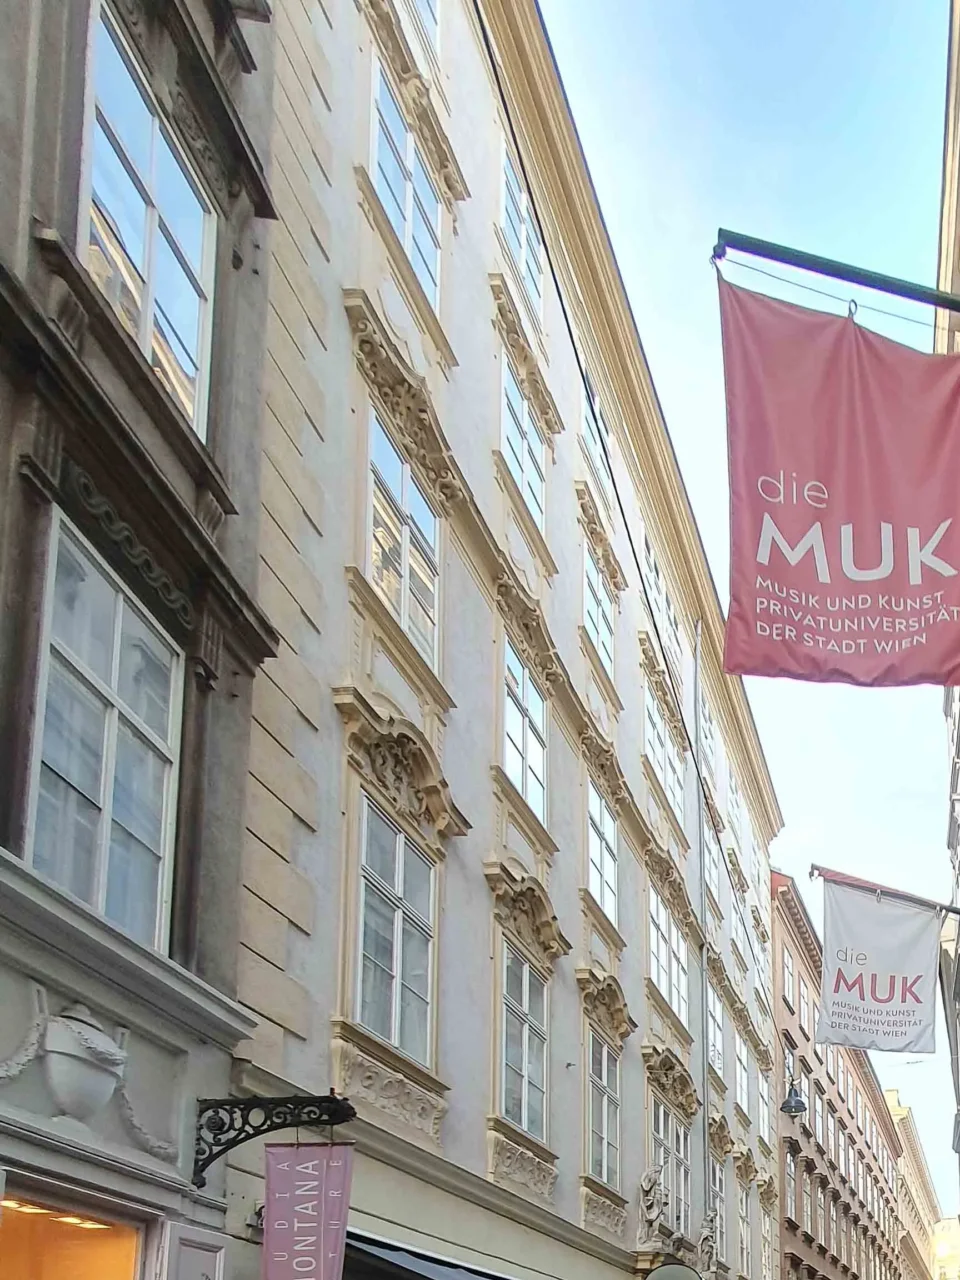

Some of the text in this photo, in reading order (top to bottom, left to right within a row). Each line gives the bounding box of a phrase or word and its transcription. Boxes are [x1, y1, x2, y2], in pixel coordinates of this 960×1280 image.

[757, 470, 829, 508] die
[756, 511, 959, 585] MUK
[756, 575, 945, 612] MUSIK UND KUNST
[756, 598, 960, 632] PRIVATUNIVERSITÄT
[756, 621, 927, 654] DER STADT WIEN
[836, 946, 868, 966] die
[833, 967, 923, 1004] MUK
[832, 1001, 916, 1017] MUSIK UND KUNST
[830, 1021, 850, 1031] DER
[851, 1023, 880, 1036] STADT
